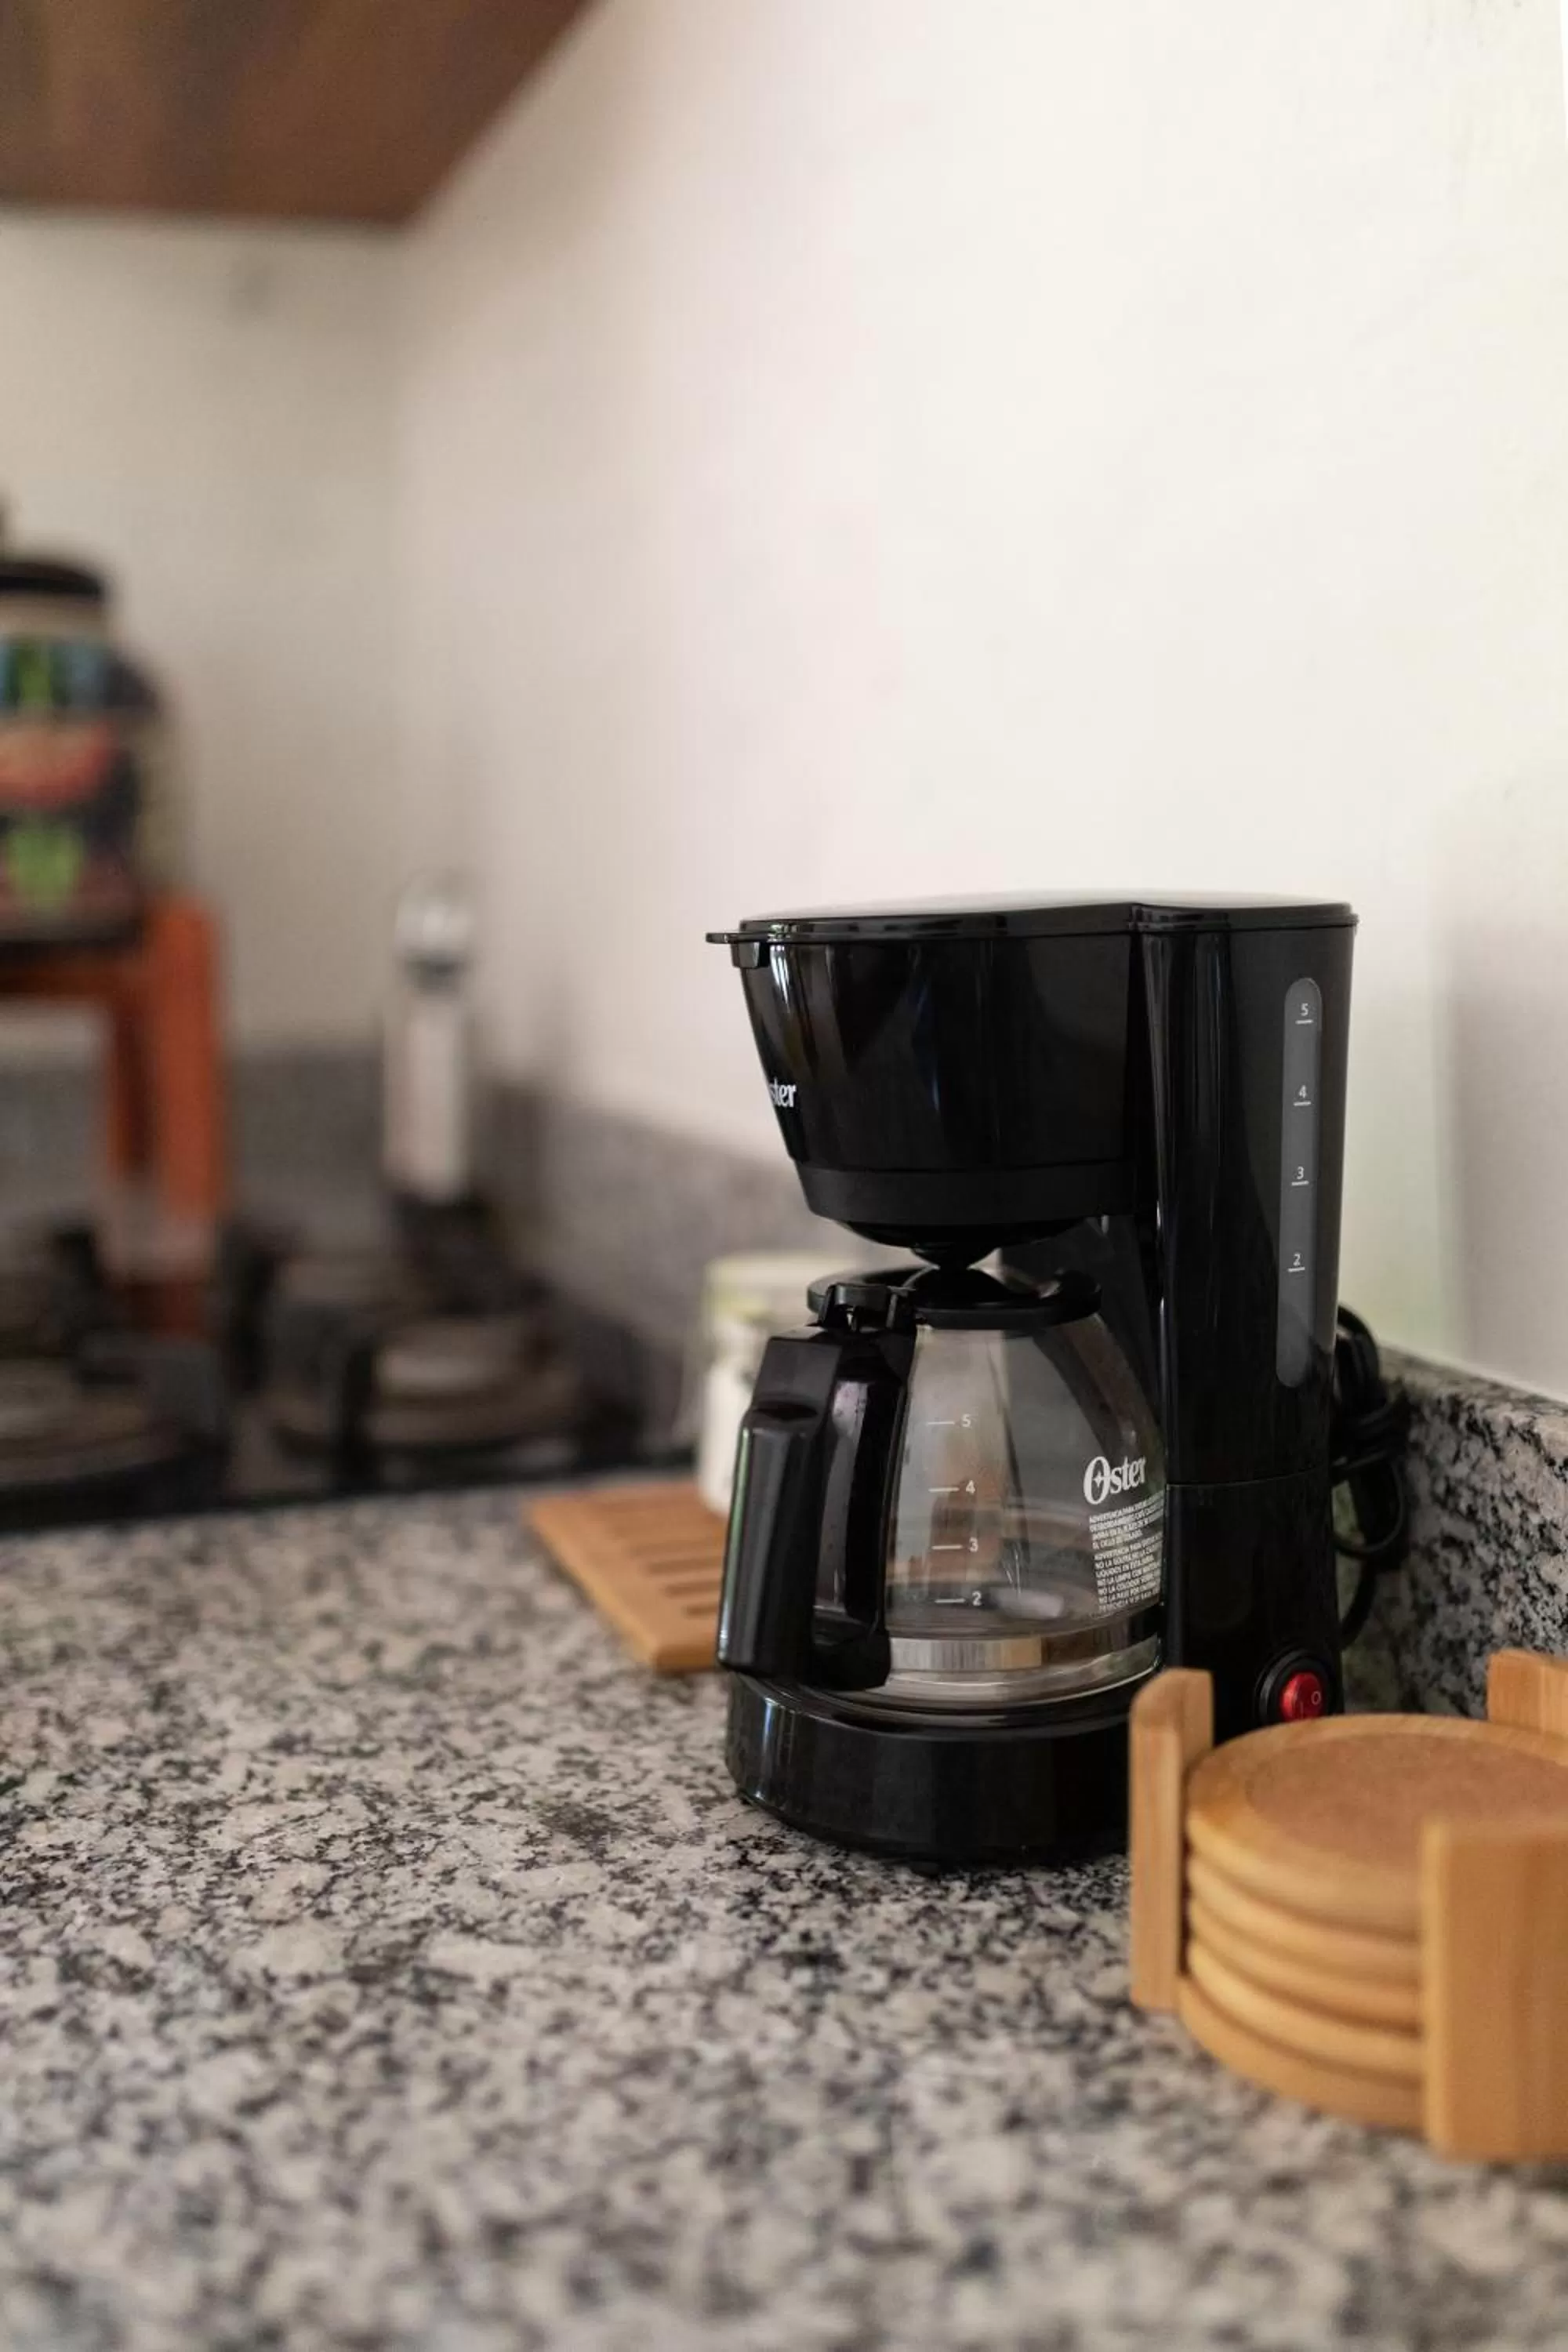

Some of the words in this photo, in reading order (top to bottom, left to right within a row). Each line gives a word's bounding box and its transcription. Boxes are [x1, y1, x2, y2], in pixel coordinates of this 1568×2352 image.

[1301, 1003, 1308, 1016] 5
[769, 1077, 797, 1108] ster
[1298, 1085, 1307, 1098] 4
[1297, 1167, 1304, 1179] 3
[1294, 1253, 1301, 1266] 2
[962, 1414, 971, 1427] 5
[965, 1479, 975, 1494] 4
[1083, 1456, 1146, 1504] Oster
[969, 1537, 978, 1552] 3
[972, 1591, 982, 1606] 2
